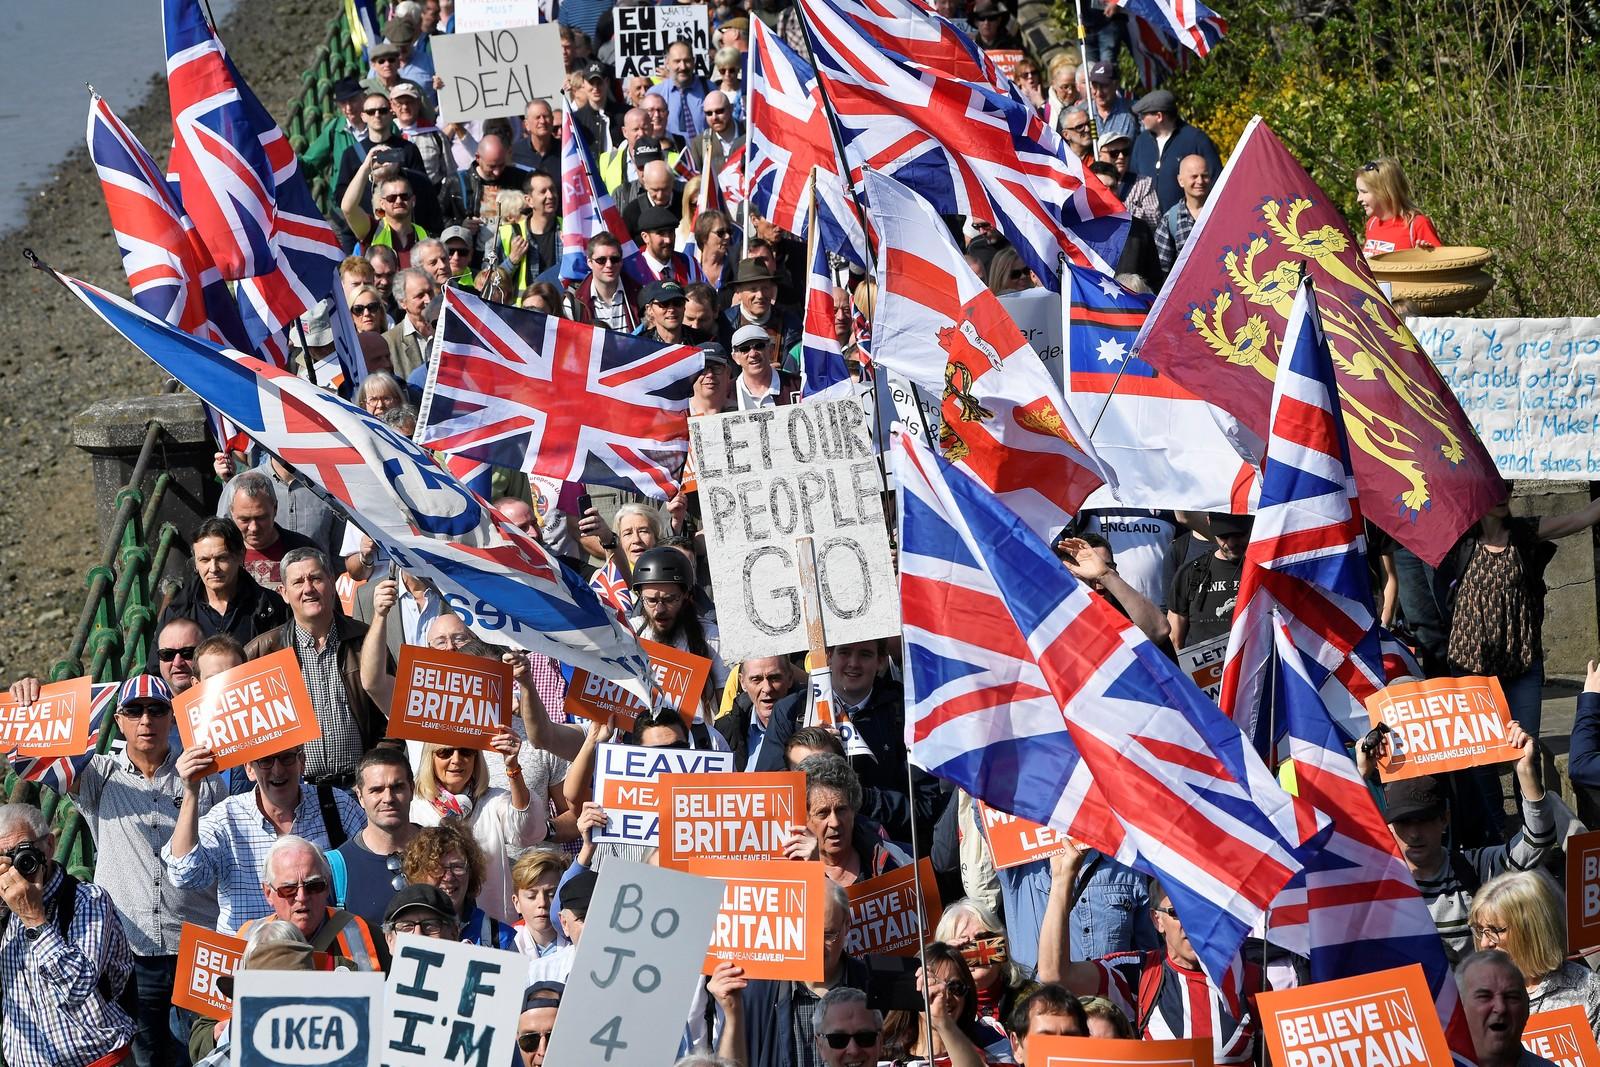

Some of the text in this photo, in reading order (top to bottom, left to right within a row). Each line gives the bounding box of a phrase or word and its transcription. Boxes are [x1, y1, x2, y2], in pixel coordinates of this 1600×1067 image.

[619, 7, 656, 31] EU
[474, 29, 519, 67] NO
[620, 54, 714, 78] AGEA
[453, 64, 553, 112] DEAL
[1516, 340, 1552, 360] are
[1559, 338, 1600, 367] gro
[1442, 366, 1520, 389] olerably
[693, 410, 775, 479] LET
[787, 399, 873, 464] OUR
[529, 475, 556, 490] uropean
[708, 461, 885, 545] PEOPLE
[1100, 522, 1161, 535] ENGLAND
[742, 536, 873, 637] GO
[1191, 646, 1227, 667] LET'
[265, 672, 288, 697] IN
[412, 666, 501, 700] BELIEVE IN
[668, 670, 690, 694] IN
[1209, 666, 1223, 679] G
[0, 696, 74, 722] LIEVE IN
[407, 689, 500, 728] BRITAIN
[1382, 691, 1496, 727] BELIEVE IN
[0, 718, 73, 742] ITAIN
[217, 730, 283, 757] LEAVEMEANSLEAVE.EU
[421, 721, 483, 736] LEAVEMEANSLEAVE.EU
[1388, 712, 1505, 756] BRITAIN
[605, 749, 725, 778] LEAVE
[1413, 745, 1488, 764] LEAVEMEANSLEAVE.EU
[675, 793, 766, 818] BELIEVE
[771, 793, 792, 816] IN
[674, 820, 793, 853] BRITAIN
[609, 883, 680, 939] Bo
[721, 885, 804, 913] LIEVE IN
[848, 892, 902, 927] LIEVE
[708, 913, 804, 951] RITAIN
[844, 909, 927, 954] RITAIN
[196, 946, 241, 976] BELI
[590, 946, 661, 994] Jo
[716, 951, 785, 962] LEAVEMEANSLEAVE.EU
[396, 946, 502, 1018] IF
[270, 1015, 345, 1050] IKEA
[1280, 996, 1414, 1048] BELIEVE IN
[388, 1010, 496, 1067] I'M
[589, 1015, 629, 1063] 4
[1554, 1031, 1579, 1056] IN
